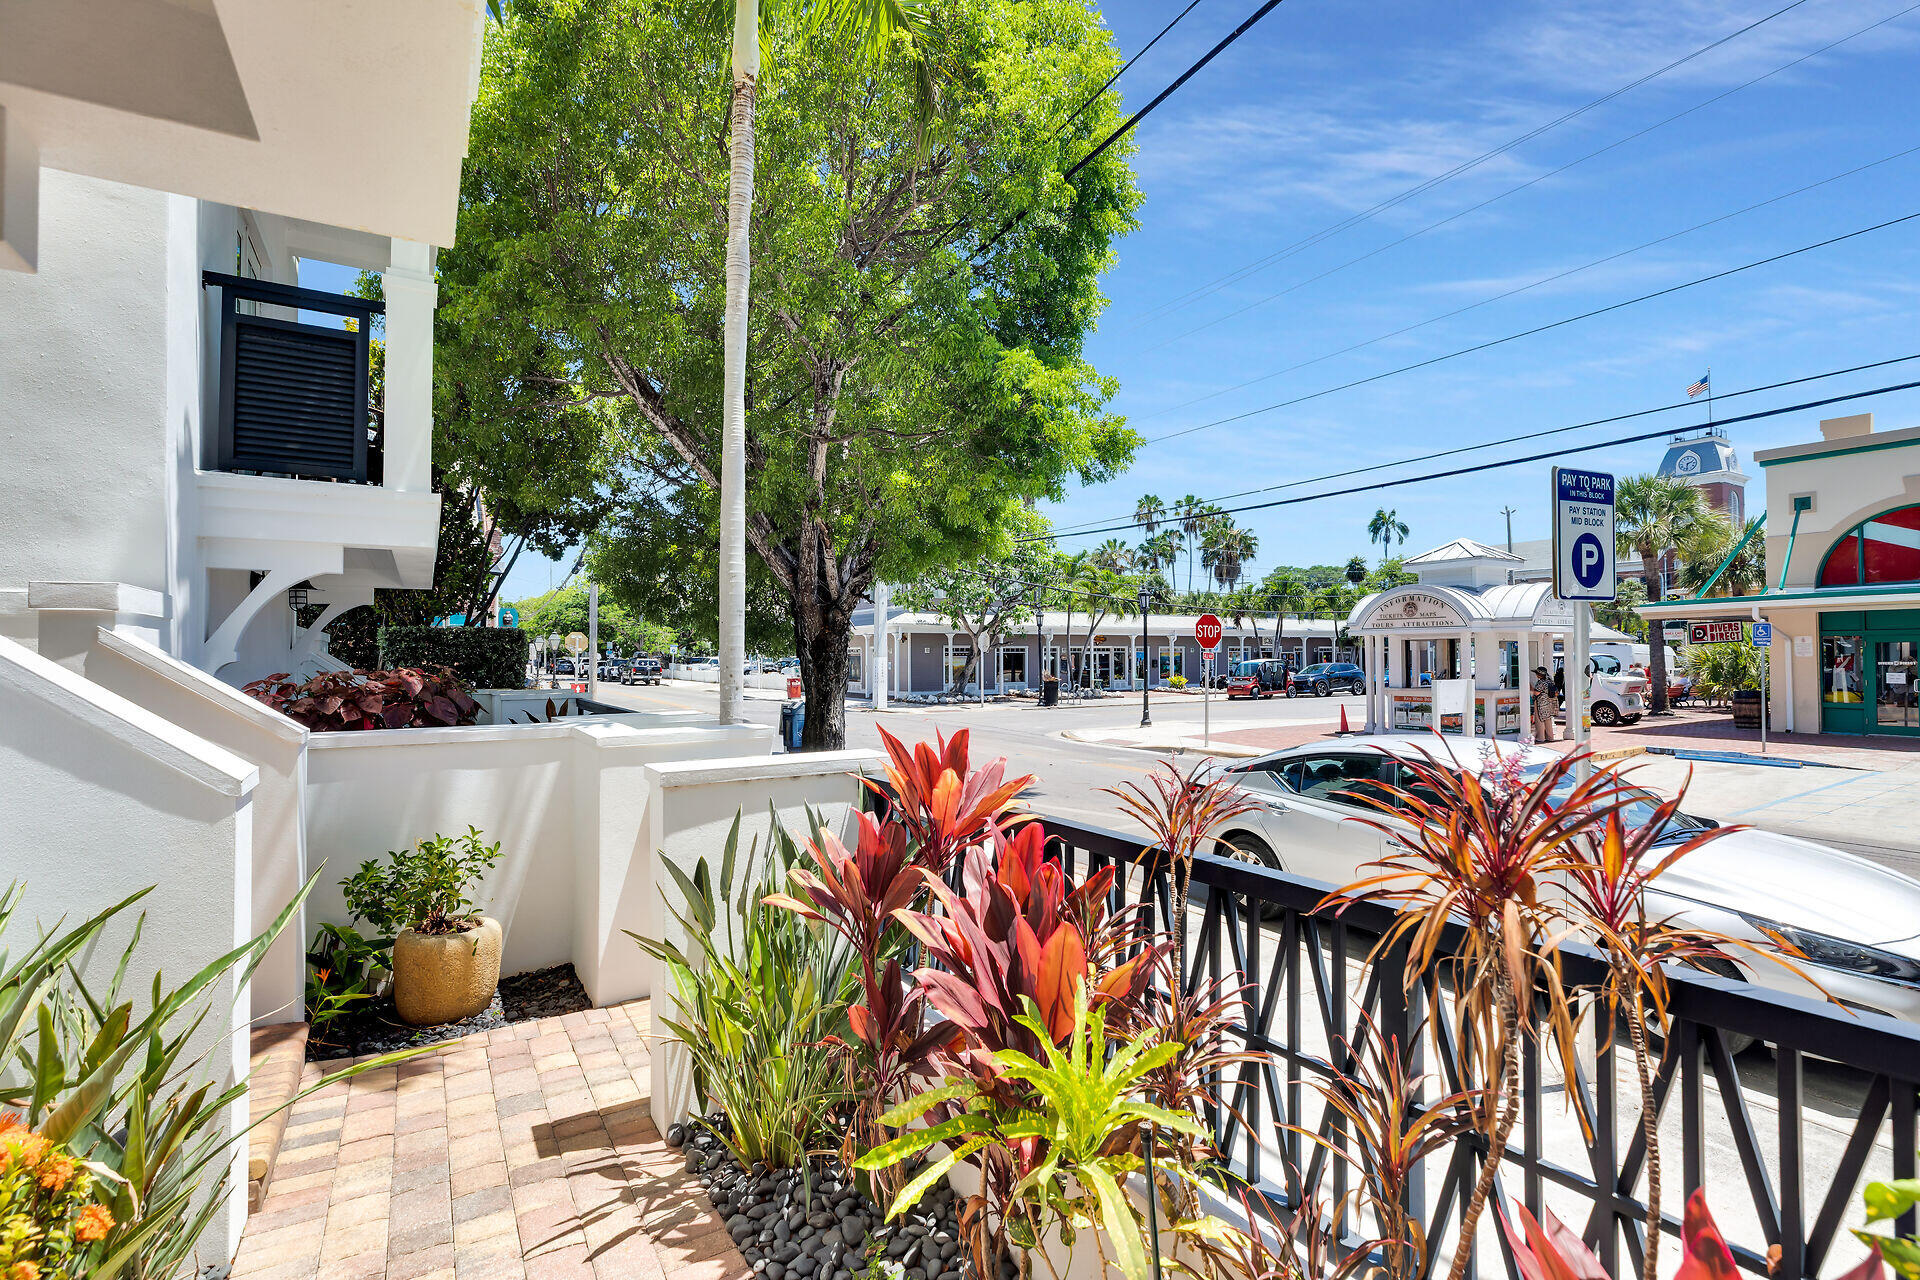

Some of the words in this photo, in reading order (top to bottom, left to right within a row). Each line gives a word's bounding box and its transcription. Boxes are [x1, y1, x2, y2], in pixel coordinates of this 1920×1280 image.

[1561, 473, 1577, 487] PAY
[1578, 475, 1590, 488] TO
[1591, 476, 1612, 491] PARK
[1570, 489, 1576, 497] IN
[1576, 490, 1588, 498] THIS
[1588, 491, 1604, 500] BLOCK
[1568, 505, 1580, 514] PAY
[1582, 506, 1606, 517] STATION
[1571, 516, 1582, 526] MID
[1584, 517, 1604, 527] BLOCK
[1582, 543, 1598, 578] P
[1380, 595, 1446, 612] INFORMATION
[1197, 624, 1220, 638] STOP
[1709, 622, 1740, 633] DIVERS
[1710, 632, 1740, 642] DIRECT
